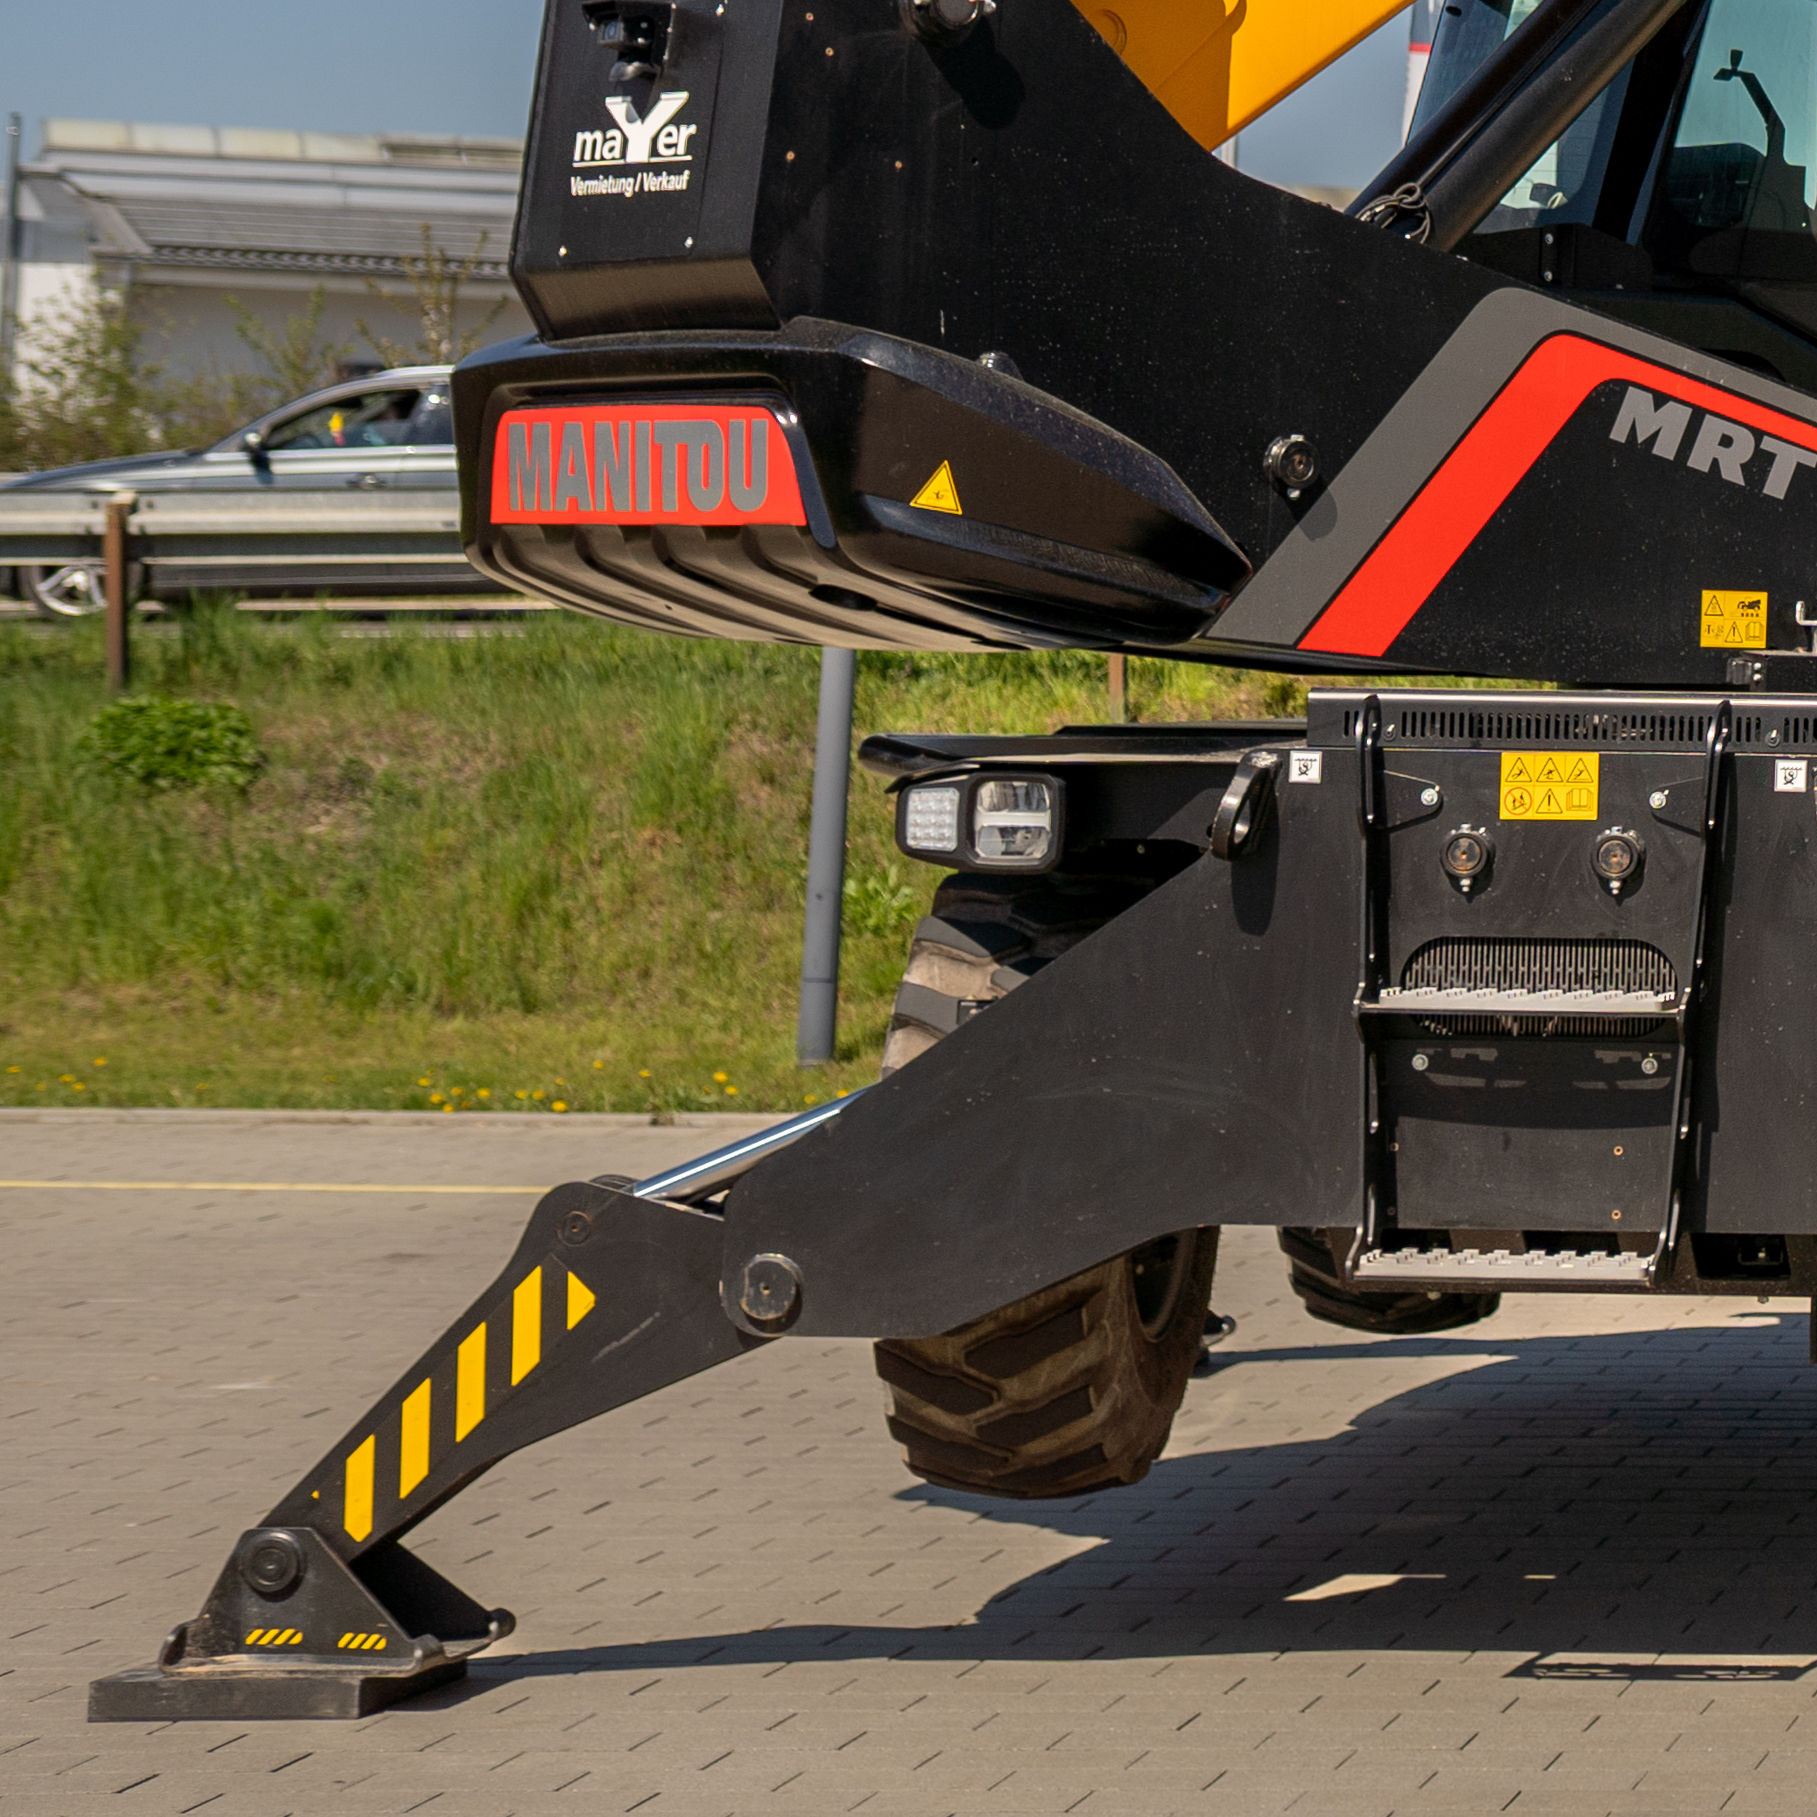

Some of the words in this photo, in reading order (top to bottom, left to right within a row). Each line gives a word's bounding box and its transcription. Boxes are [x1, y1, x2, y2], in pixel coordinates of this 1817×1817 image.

[570, 174, 636, 198] Vermietung
[642, 169, 691, 193] Verkauf
[507, 418, 770, 513] MANITOU
